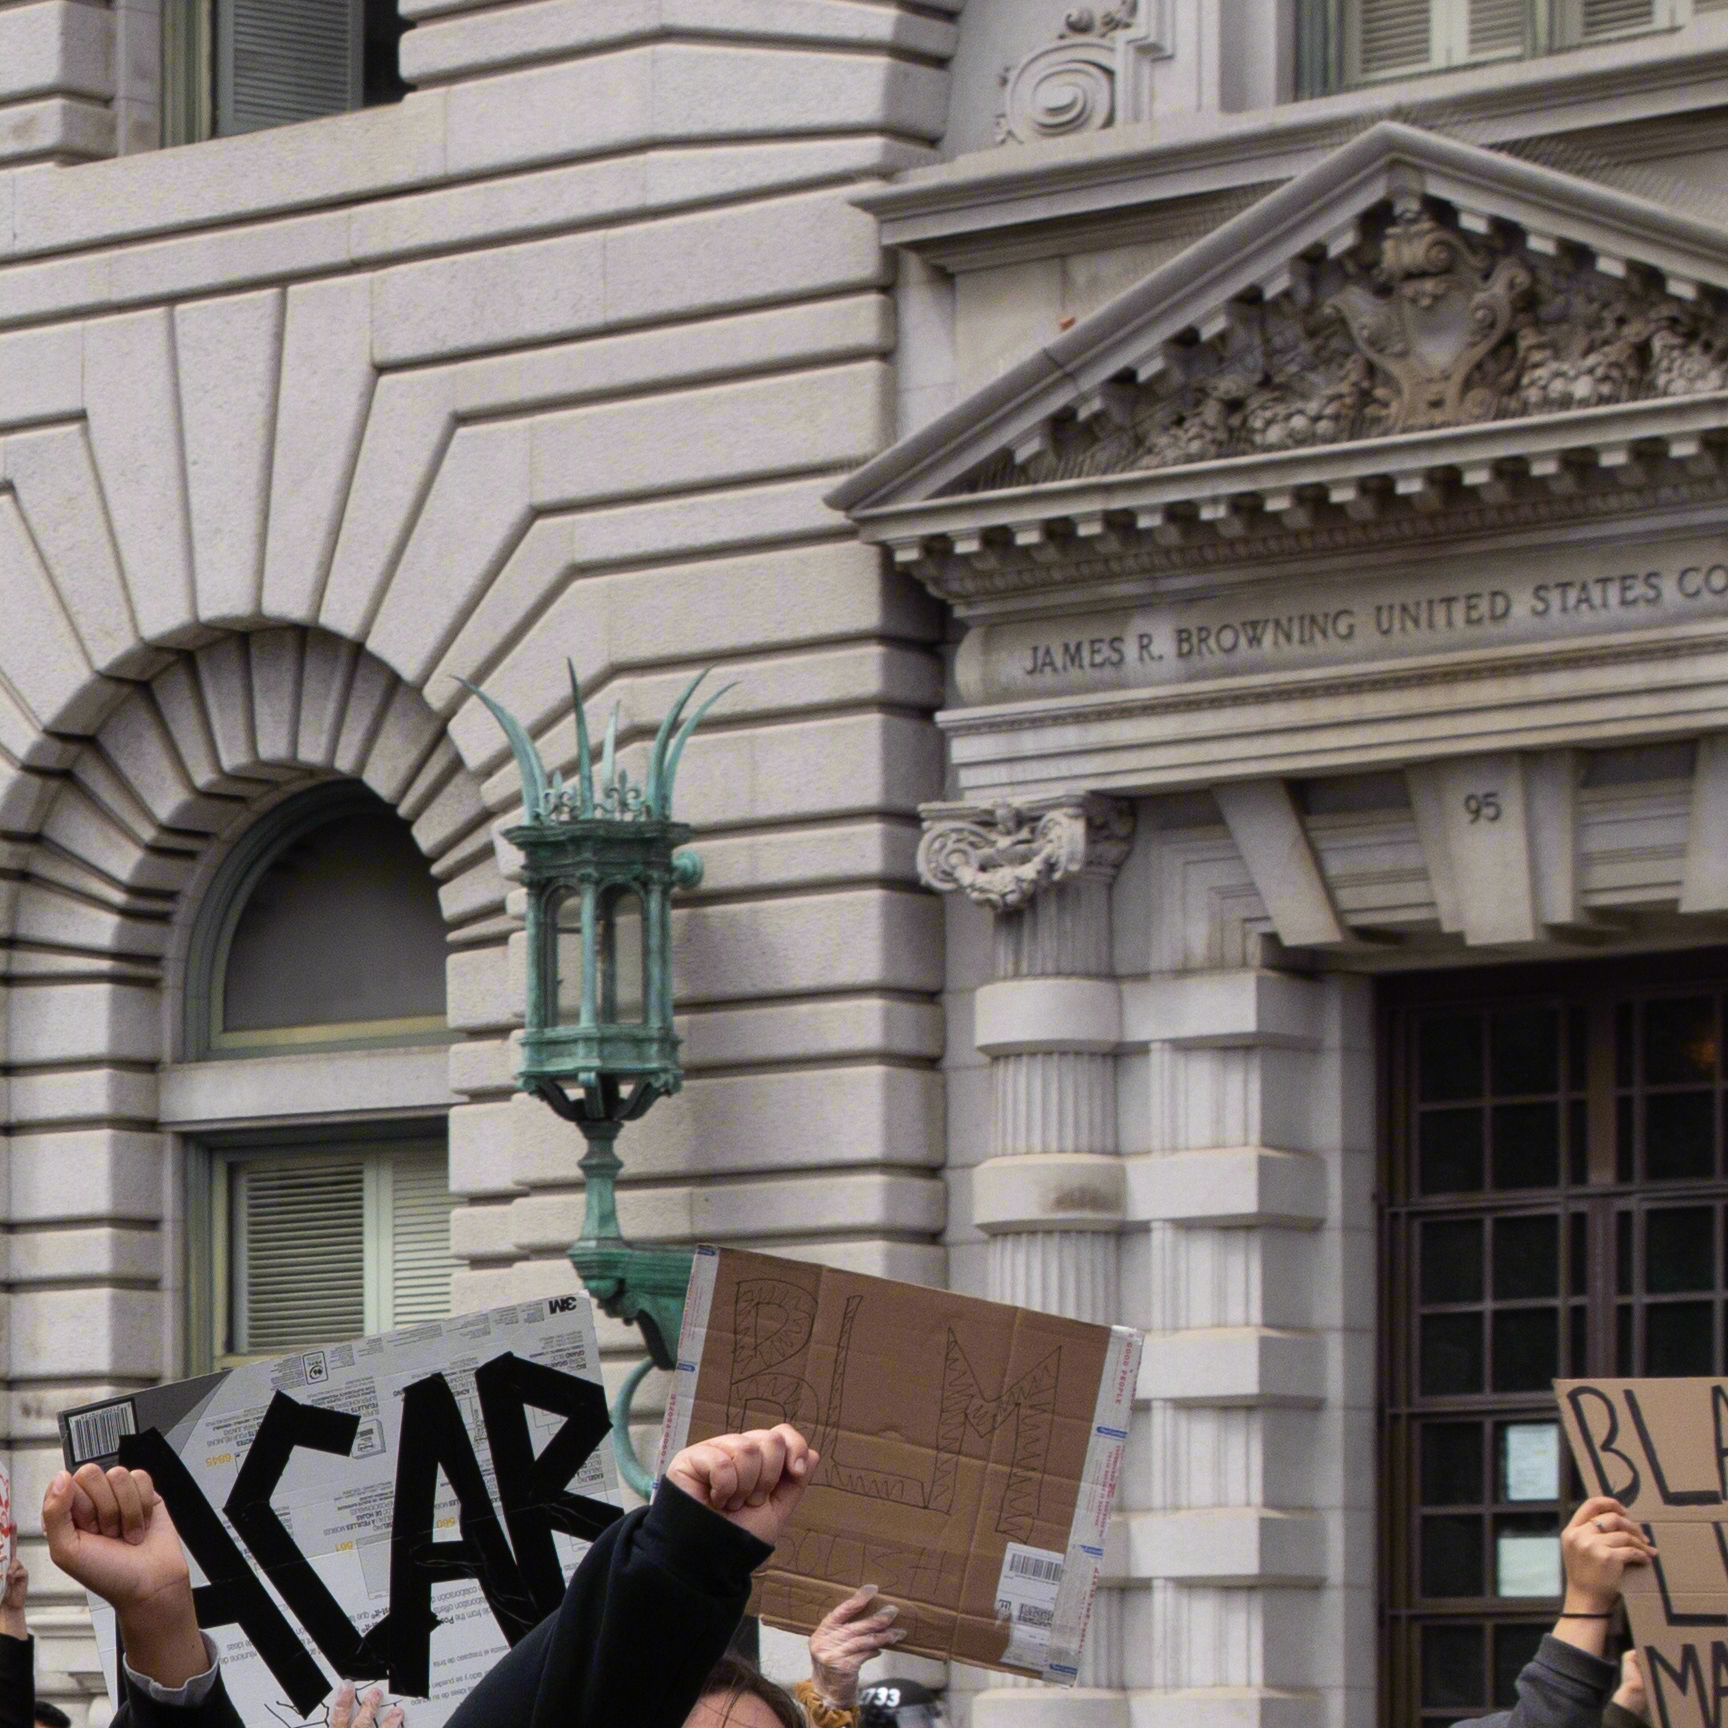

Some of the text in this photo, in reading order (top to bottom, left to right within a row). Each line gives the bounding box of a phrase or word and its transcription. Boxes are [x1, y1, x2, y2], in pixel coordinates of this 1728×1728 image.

[1024, 638, 1125, 676] JAMES
[1138, 633, 1164, 662] R.
[1175, 609, 1356, 659] BROWNING
[1374, 591, 1511, 637] UNITED
[1531, 571, 1662, 616] STATES
[1465, 792, 1502, 824] 95
[548, 1296, 577, 1314] 3M
[205, 1453, 232, 1467] 6845
[455, 1612, 466, 1622] the
[467, 1608, 482, 1618] from
